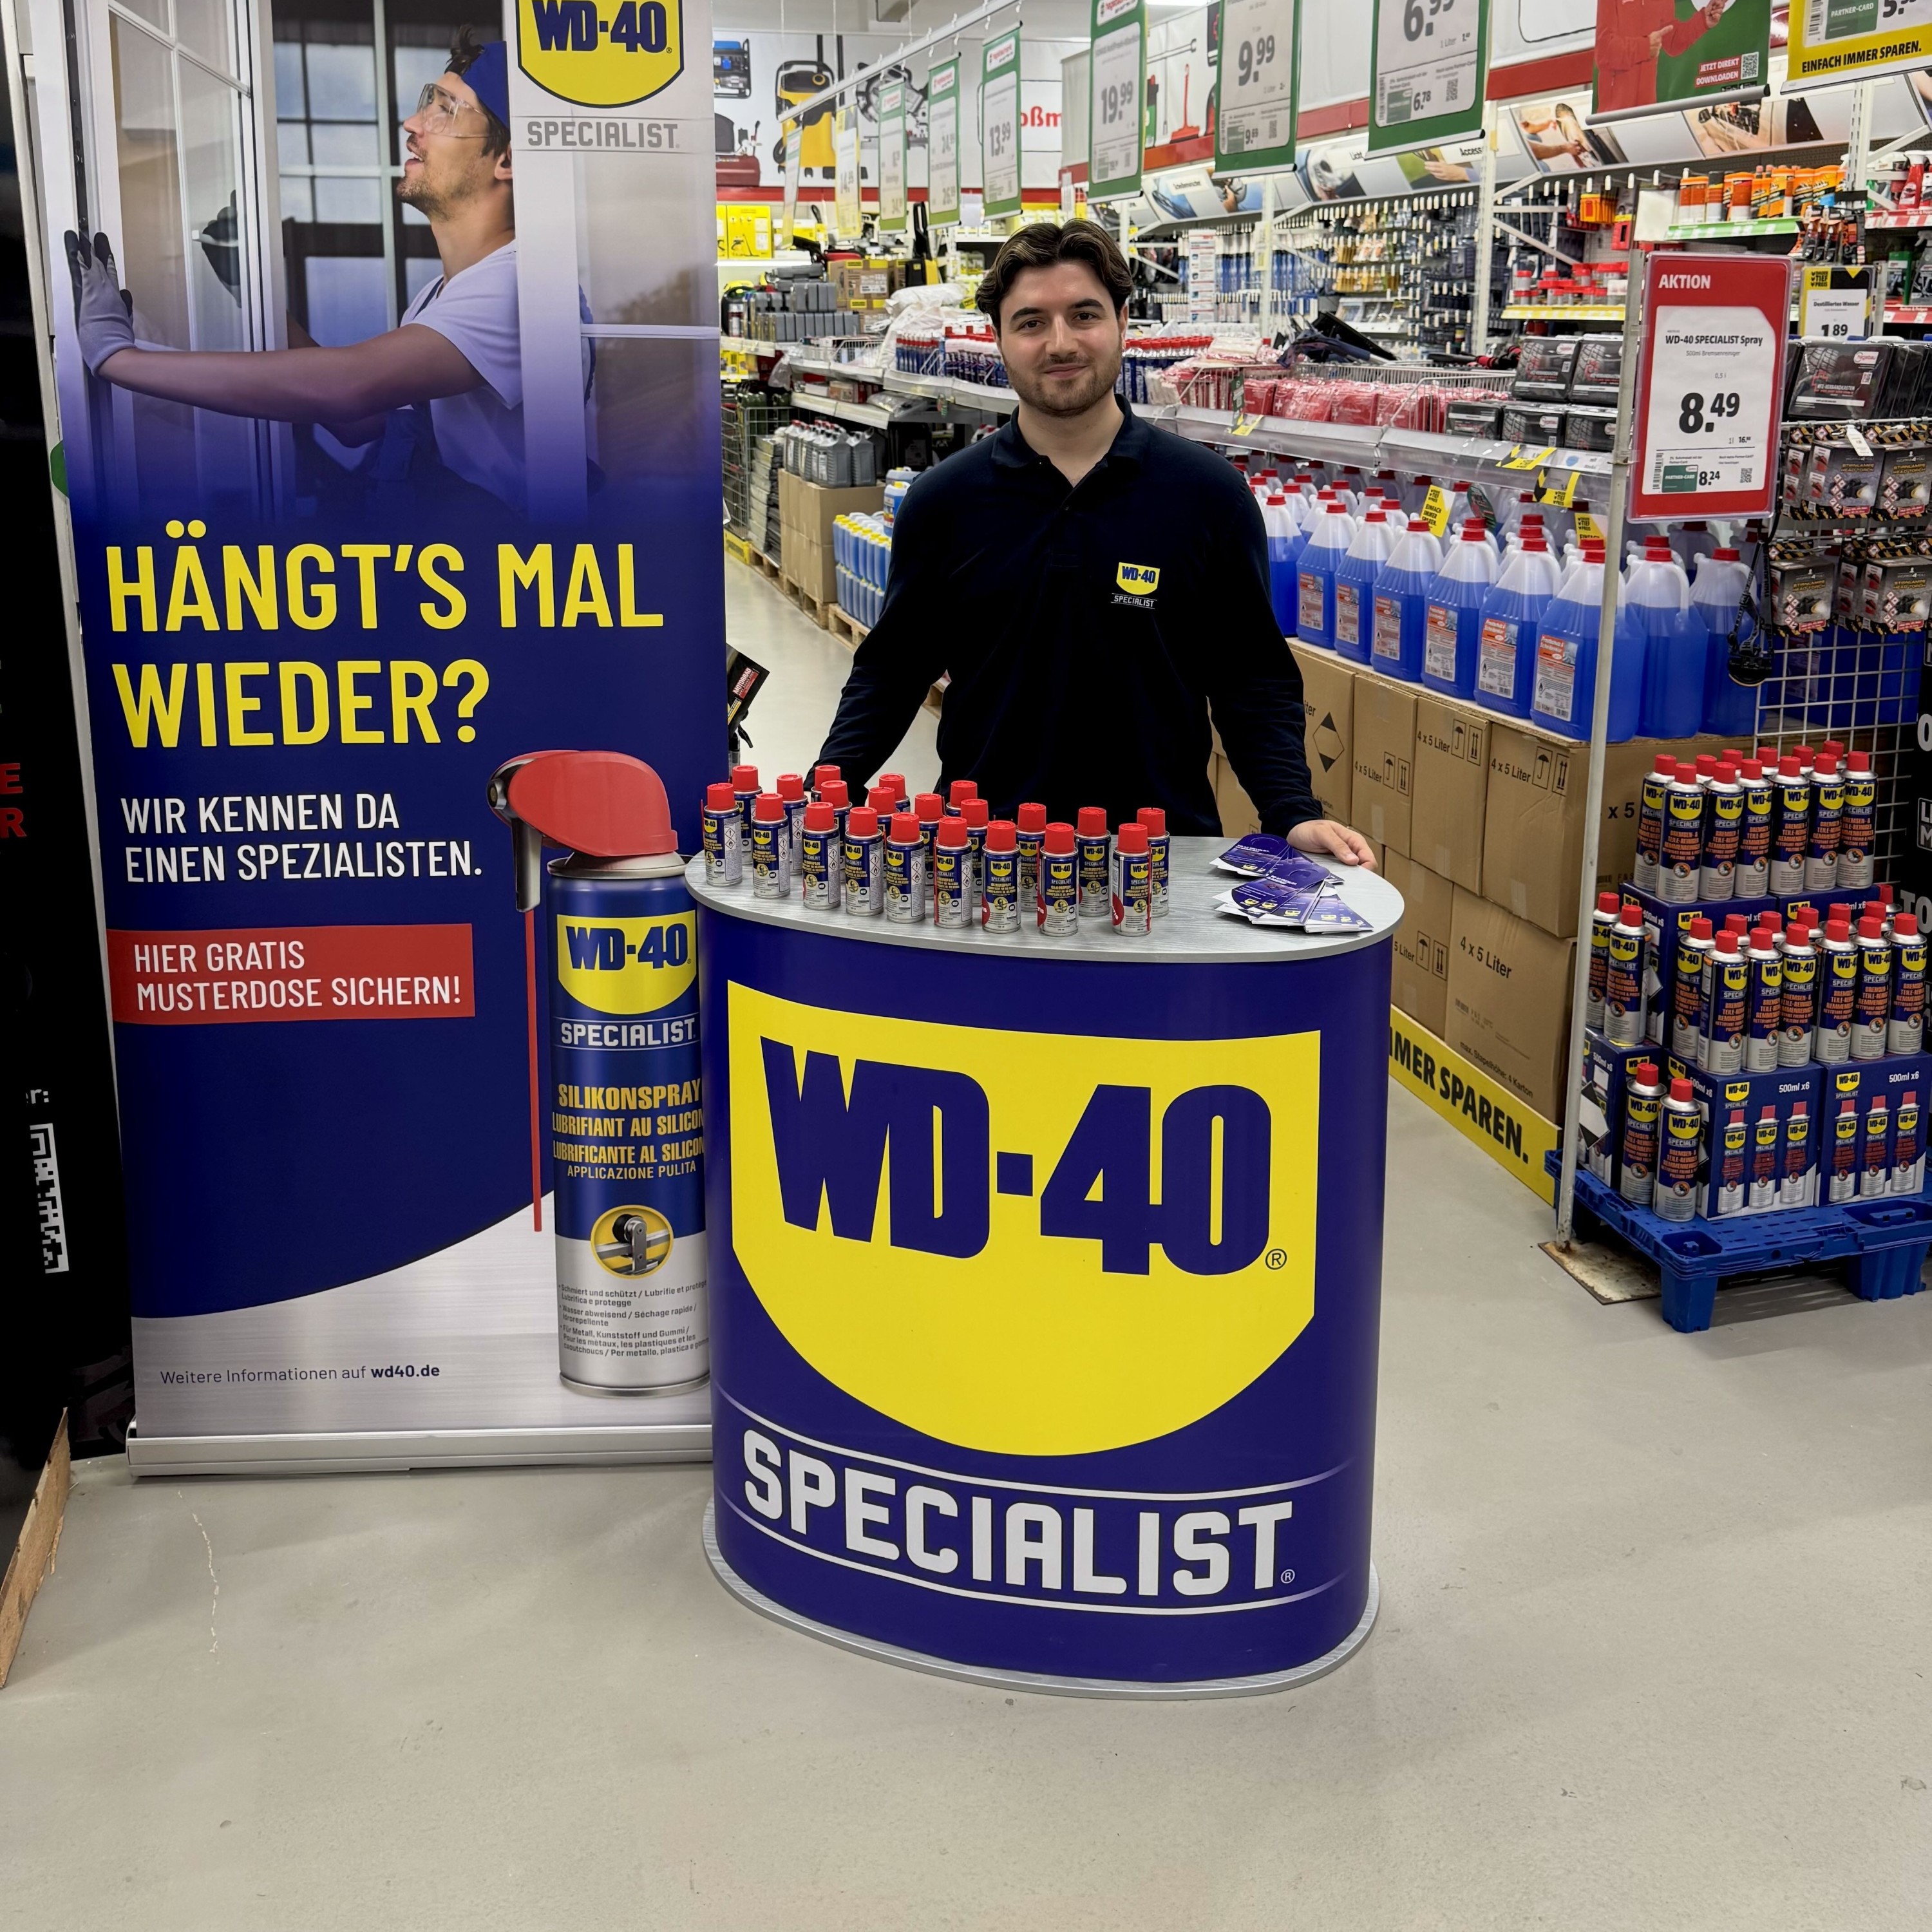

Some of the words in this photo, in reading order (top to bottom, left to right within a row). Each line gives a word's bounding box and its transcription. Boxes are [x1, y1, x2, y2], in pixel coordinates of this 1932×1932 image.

[1831, 3, 1874, 17] PARTNER-CARD
[531, 0, 667, 53] WD-40
[1238, 35, 1275, 86] 9.99
[1700, 62, 1717, 72] JETZT
[1718, 57, 1739, 69] DIREKT
[1803, 55, 1841, 73] EINFACH
[1843, 48, 1878, 66] IMMER
[1880, 41, 1922, 59] SPAREN.
[1696, 71, 1739, 85] DOWNLOADEN
[1101, 80, 1133, 124] 19.99
[1414, 90, 1431, 111] 6.78
[527, 120, 678, 149] SPECIALIST
[989, 121, 1011, 158] 13.99
[1658, 274, 1711, 289] AKTION
[1665, 335, 1694, 344] WD-40
[1694, 335, 1739, 344] SPECIALIST
[1740, 336, 1763, 346] Spray
[1679, 392, 1740, 433] 8.49
[1698, 471, 1720, 486] 8.24
[105, 519, 468, 633] HÄNGT'S
[497, 543, 665, 629] MAL
[1122, 565, 1156, 584] WD-40
[1113, 595, 1154, 607] SPECIALIST
[732, 667, 752, 694] MOTORRAD
[111, 658, 490, 749] WIEDER?
[1417, 730, 1421, 741] 4
[1428, 735, 1433, 746] 5
[1434, 737, 1450, 753] Liter
[1363, 765, 1367, 775] 5
[1368, 768, 1382, 783] Liter
[1491, 758, 1496, 770] 4
[1498, 762, 1502, 772] x
[1504, 763, 1510, 775] 5
[1512, 766, 1531, 782] Liter
[1788, 791, 1808, 802] WD-4
[1824, 790, 1843, 800] WD-4
[1845, 785, 1872, 796] WD-40
[1624, 802, 1634, 819] 5
[1673, 798, 1700, 810] WD-40
[121, 797, 187, 834] WIR
[198, 793, 343, 833] KENNEN
[357, 793, 400, 829] DA
[125, 845, 226, 883] EINEN
[237, 840, 482, 880] SPEZIALISTEN.
[565, 922, 688, 971] WD-40
[1394, 941, 1398, 951] 5
[1399, 943, 1415, 962] Liter
[1611, 938, 1636, 952] WD-40
[134, 943, 197, 973] HIER
[206, 940, 305, 971] GRATIS
[1460, 936, 1466, 951] 4
[1468, 943, 1474, 957] x
[1477, 947, 1484, 962] 5
[1486, 951, 1512, 979] Liter
[1868, 953, 1891, 965] WD-4
[1906, 950, 1927, 961] WD-4
[1786, 961, 1814, 972] WD-40
[136, 978, 323, 1011] MUSTERDOSE
[331, 975, 462, 1006] SICHERN!
[561, 1017, 696, 1047] SPECIALIST
[1839, 1074, 1858, 1084] WD-40
[1889, 1072, 1909, 1083] 500ml
[1910, 1071, 1919, 1080] x6
[558, 1078, 701, 1110] SILIKONSPRAY
[1388, 1026, 1435, 1090] MER
[1439, 1066, 1529, 1164] SPAREN.
[1513, 1077, 1533, 1099] Karton
[1728, 1084, 1748, 1094] WD-40
[1779, 1083, 1800, 1094] 500ml
[1801, 1081, 1810, 1091] x6
[1630, 1099, 1658, 1113] WD-40
[552, 1111, 625, 1137] LUBRIFIANT
[630, 1117, 652, 1137] AU
[657, 1108, 704, 1135] SILICON
[1672, 1117, 1699, 1128] WD-40
[1869, 1118, 1886, 1127] WD-40
[1900, 1114, 1917, 1123] WD-40
[1758, 1129, 1776, 1138] WD-40
[1789, 1124, 1806, 1133] WD-40
[1839, 1122, 1855, 1132] WD-40
[553, 1139, 636, 1164] LUBRIFICANTE
[639, 1144, 658, 1164] AL
[661, 1135, 705, 1162] SILICON
[761, 1035, 1271, 1276] WD-40
[567, 1165, 654, 1180] APPLICAZIONE
[658, 1159, 696, 1178] PULITA
[561, 1284, 588, 1296] Schmiert
[645, 1288, 676, 1297] Lubrifie
[562, 1293, 587, 1304] Lubrifica
[594, 1299, 632, 1307] protegge
[562, 1305, 583, 1316] Wasser
[585, 1310, 627, 1318] abweisend
[634, 1309, 669, 1318] Séchage
[562, 1314, 609, 1327] Idrorepellente
[563, 1325, 572, 1333] Für
[572, 1329, 595, 1339] Metall,
[596, 1331, 641, 1339] Kunststoff
[563, 1333, 575, 1343] Pour
[576, 1336, 586, 1345] les
[587, 1338, 619, 1349] métaux,
[634, 1338, 677, 1349] plastiques
[564, 1342, 603, 1356] caoutchoucs
[626, 1349, 659, 1357] metallo,
[660, 1343, 689, 1356] plastica
[160, 1370, 222, 1384] Weitere
[227, 1367, 337, 1383] Informationen
[342, 1365, 367, 1379] auf
[370, 1363, 440, 1379] wd40.de
[743, 1428, 1293, 1597] SPECIALIST
